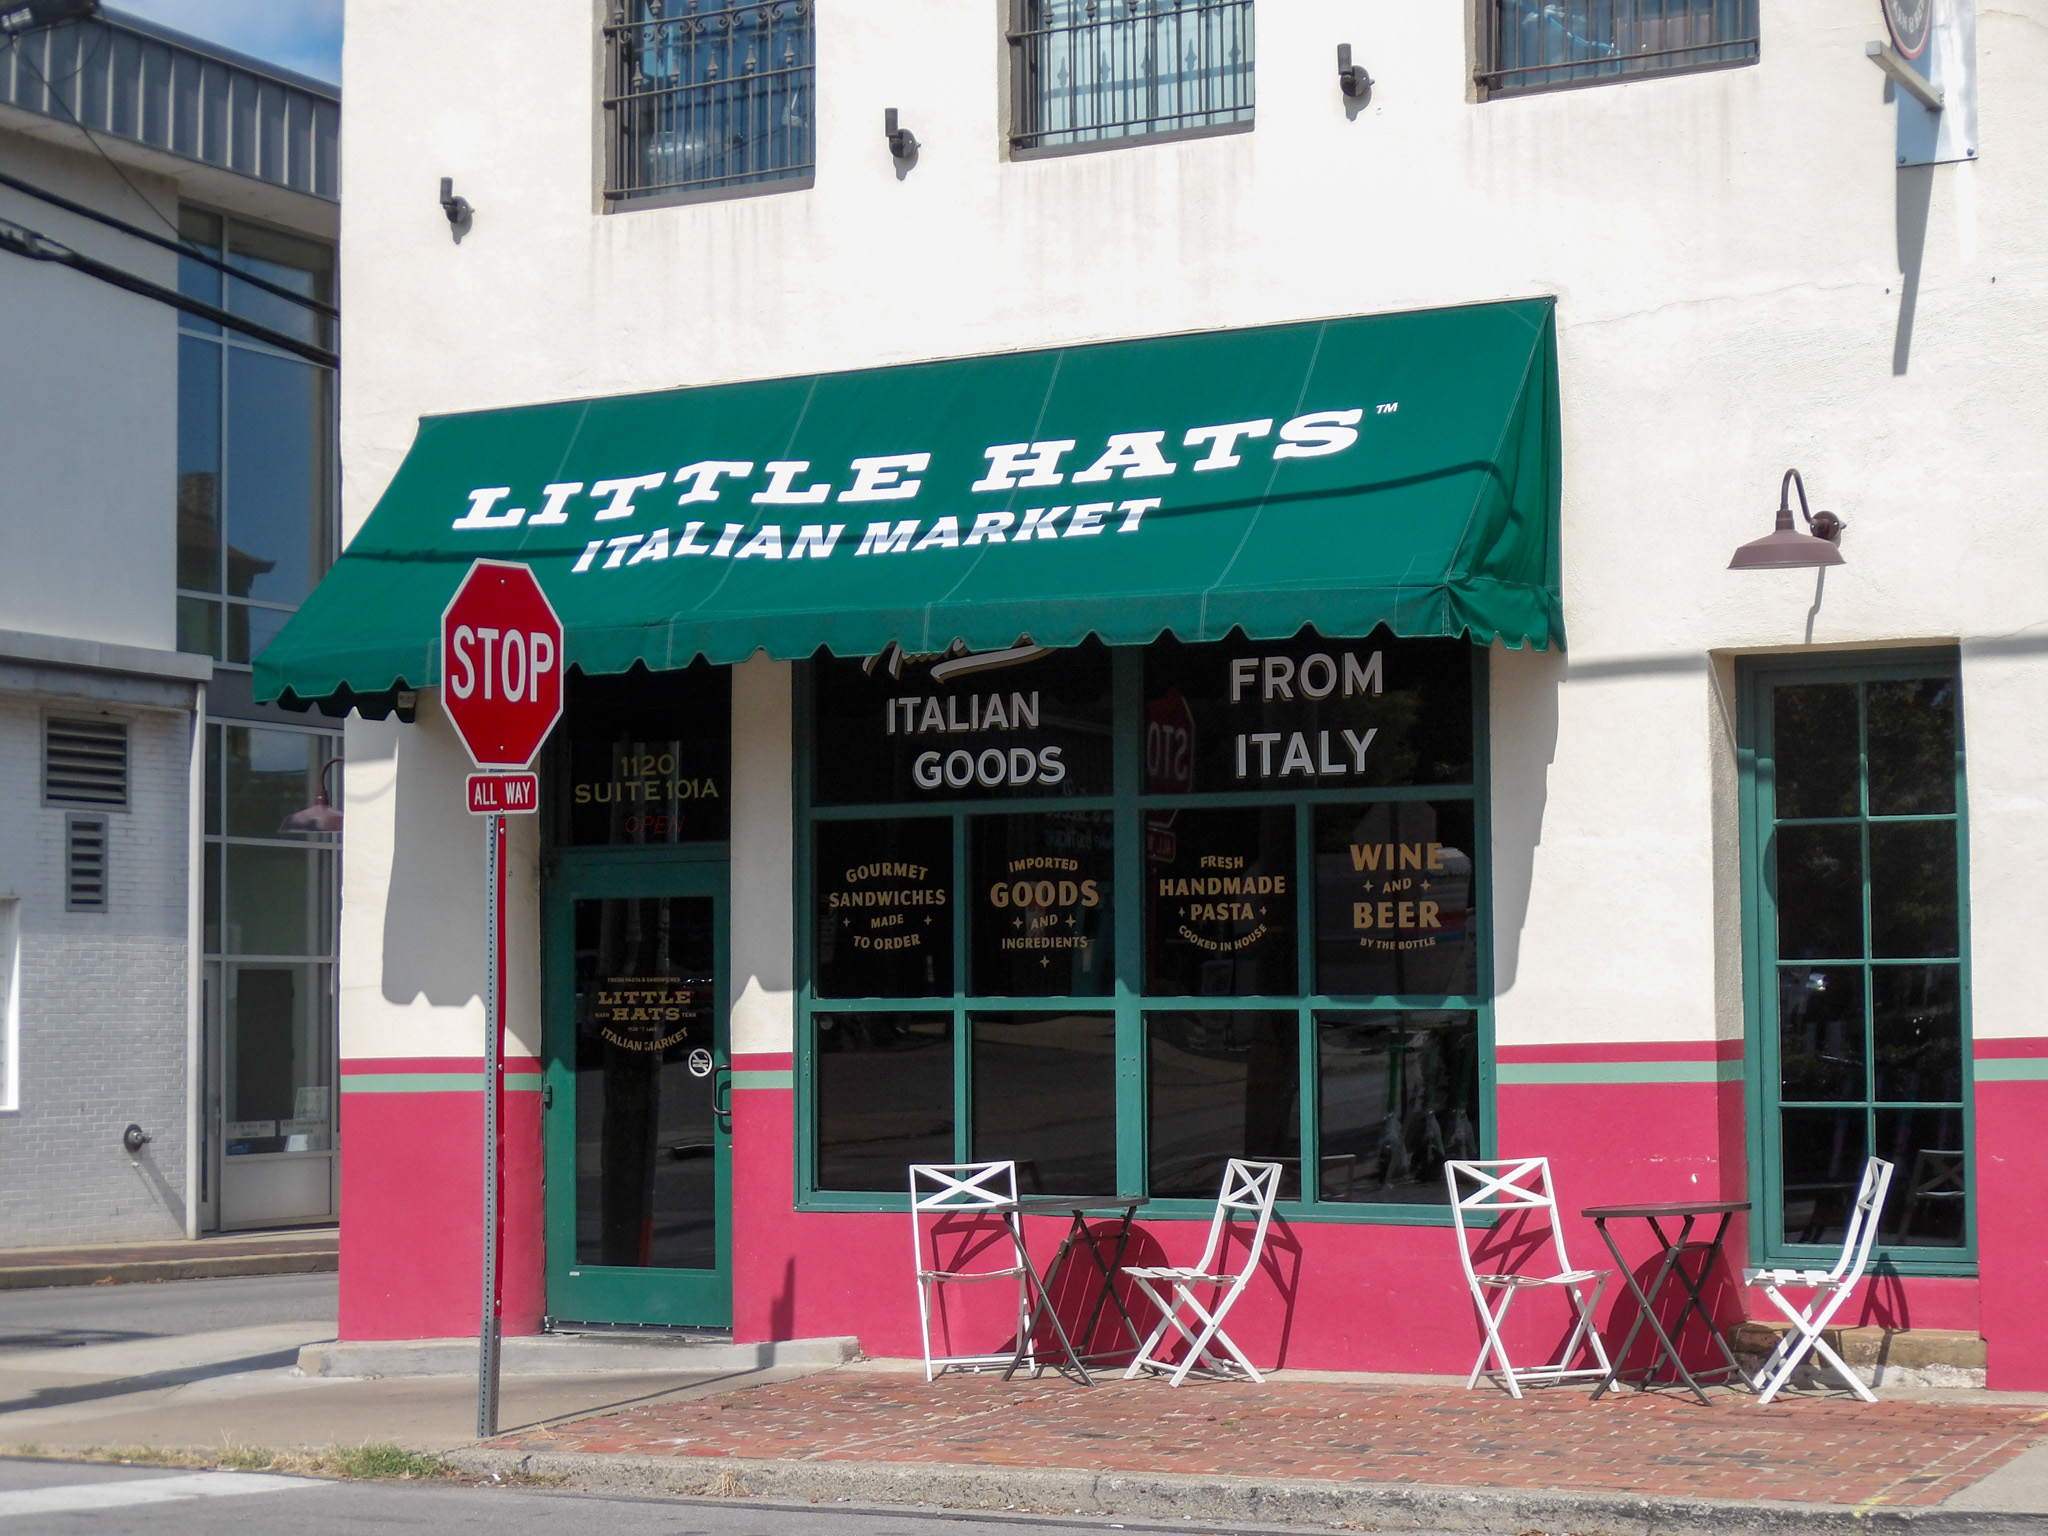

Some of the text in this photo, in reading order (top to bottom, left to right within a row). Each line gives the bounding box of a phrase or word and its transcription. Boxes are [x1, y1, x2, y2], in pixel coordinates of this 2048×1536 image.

[452, 452, 932, 530] LITTLE
[970, 408, 1364, 493] HATS
[571, 497, 1162, 573] ITALIAN MARKET
[451, 624, 554, 702] STOP
[1230, 650, 1383, 704] FROM
[886, 690, 1040, 736] ITALIAN
[1236, 727, 1378, 778] ITALY
[620, 754, 676, 777] 1120
[912, 746, 1066, 790] GOODS
[474, 781, 531, 805] ALL WAY
[575, 778, 719, 803] SUITE 101A
[625, 815, 686, 834] OPEN
[1008, 856, 1079, 873] IMPORTED
[1200, 855, 1244, 870] FRESH
[1350, 842, 1444, 872] WINE
[845, 862, 929, 883] GOURMET
[990, 879, 1099, 908] GOODS
[1159, 875, 1286, 897] HANDMADE
[1382, 877, 1412, 894] AND
[829, 889, 946, 908] SANDWICHES
[870, 914, 904, 929] MADE
[1030, 914, 1058, 930] AND
[1190, 902, 1255, 921] PASTA
[1353, 900, 1443, 929] BEER
[853, 933, 921, 950] TO ORDER
[1001, 936, 1088, 950] INGREDIENTS
[1178, 922, 1267, 951] COOKED IN HOUSE
[1360, 936, 1436, 950] BY THE BOTTLE
[598, 991, 691, 1005] LITTLE
[612, 1007, 680, 1021] HATS
[601, 1026, 689, 1051] ITALIAN MARKET
